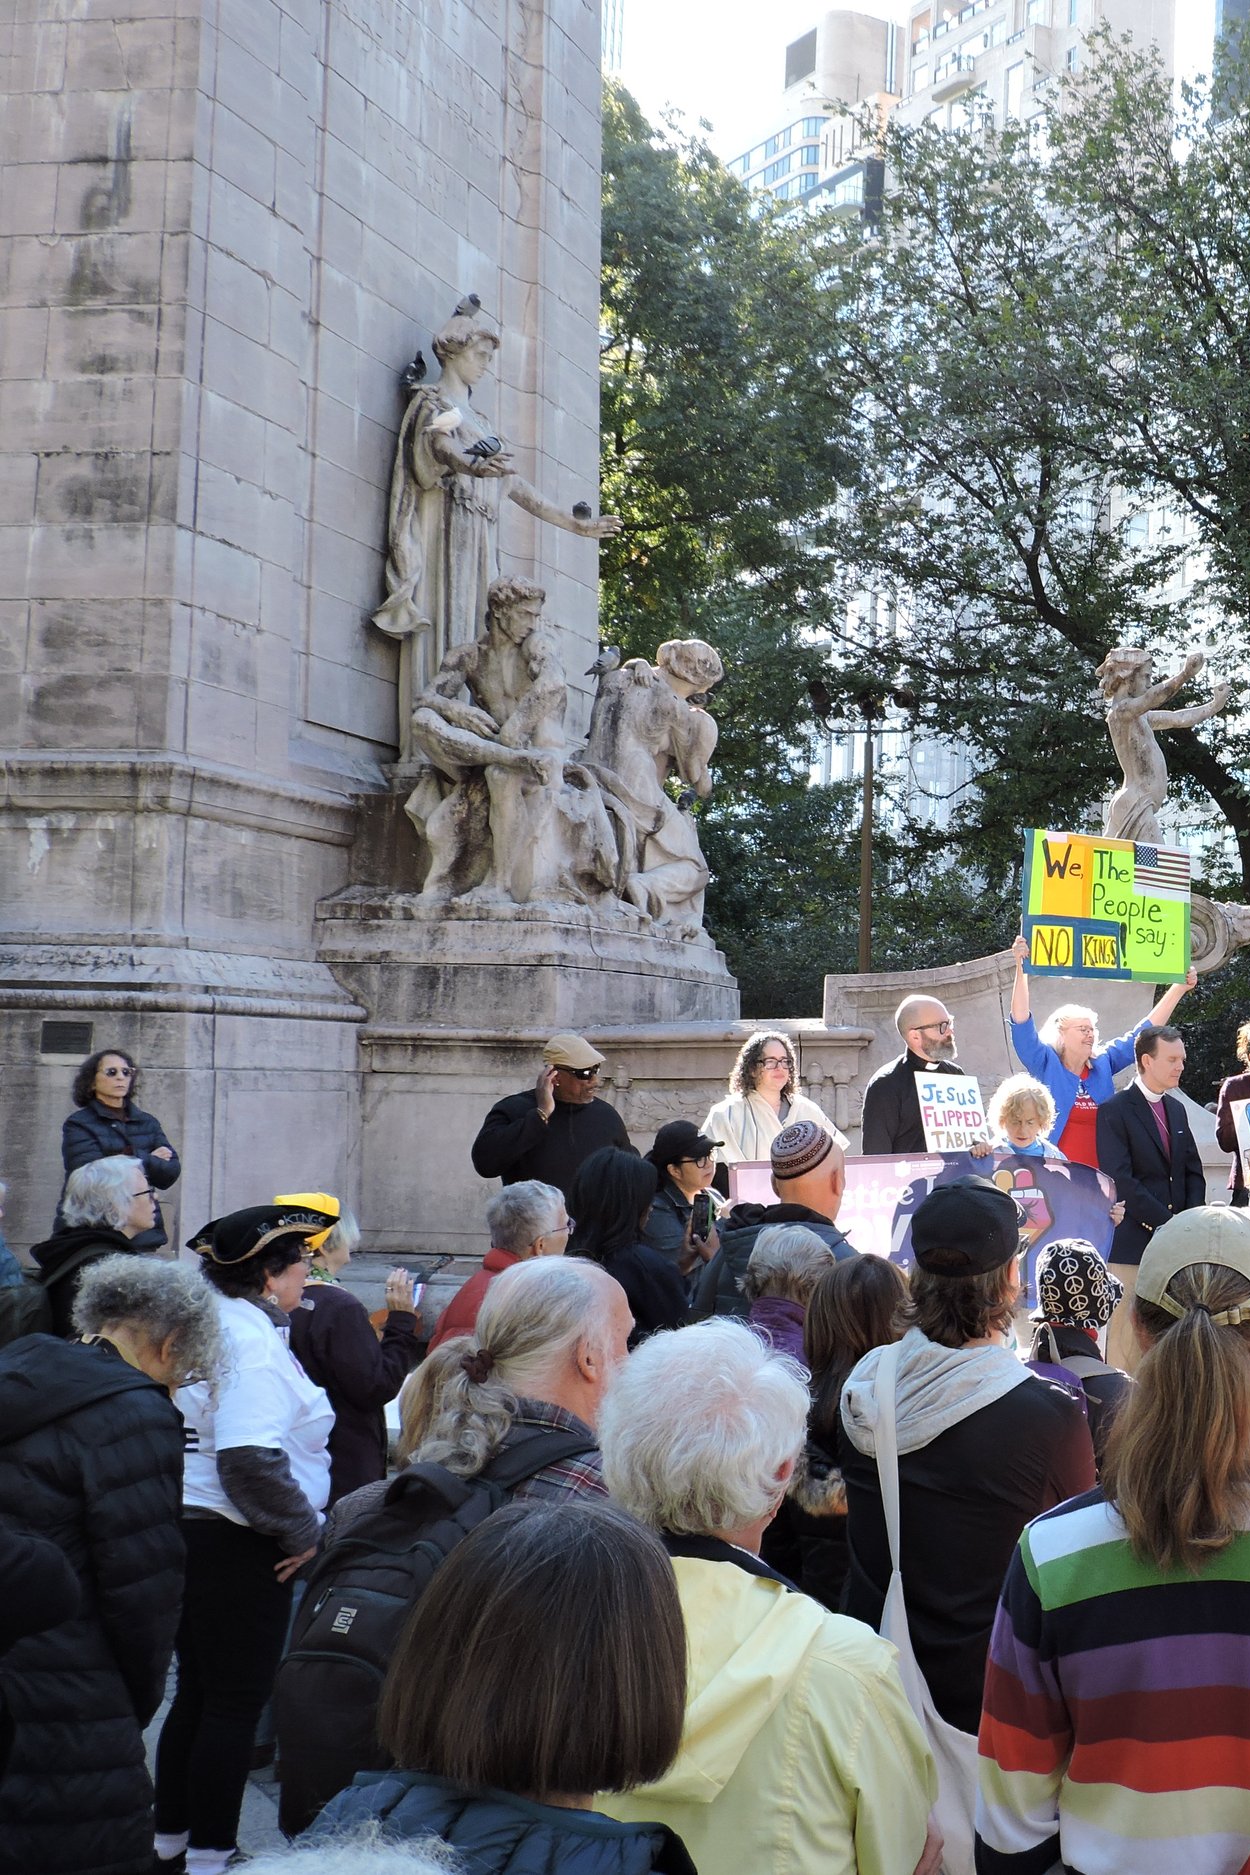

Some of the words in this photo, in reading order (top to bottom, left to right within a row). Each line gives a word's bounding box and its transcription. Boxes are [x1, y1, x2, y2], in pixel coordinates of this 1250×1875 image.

[1094, 850, 1131, 883] The
[1092, 883, 1162, 935] People
[1033, 927, 1070, 966] NO
[921, 1083, 976, 1106] JESUS
[922, 1105, 983, 1128] FLIPPED
[283, 1213, 327, 1227] KINGS
